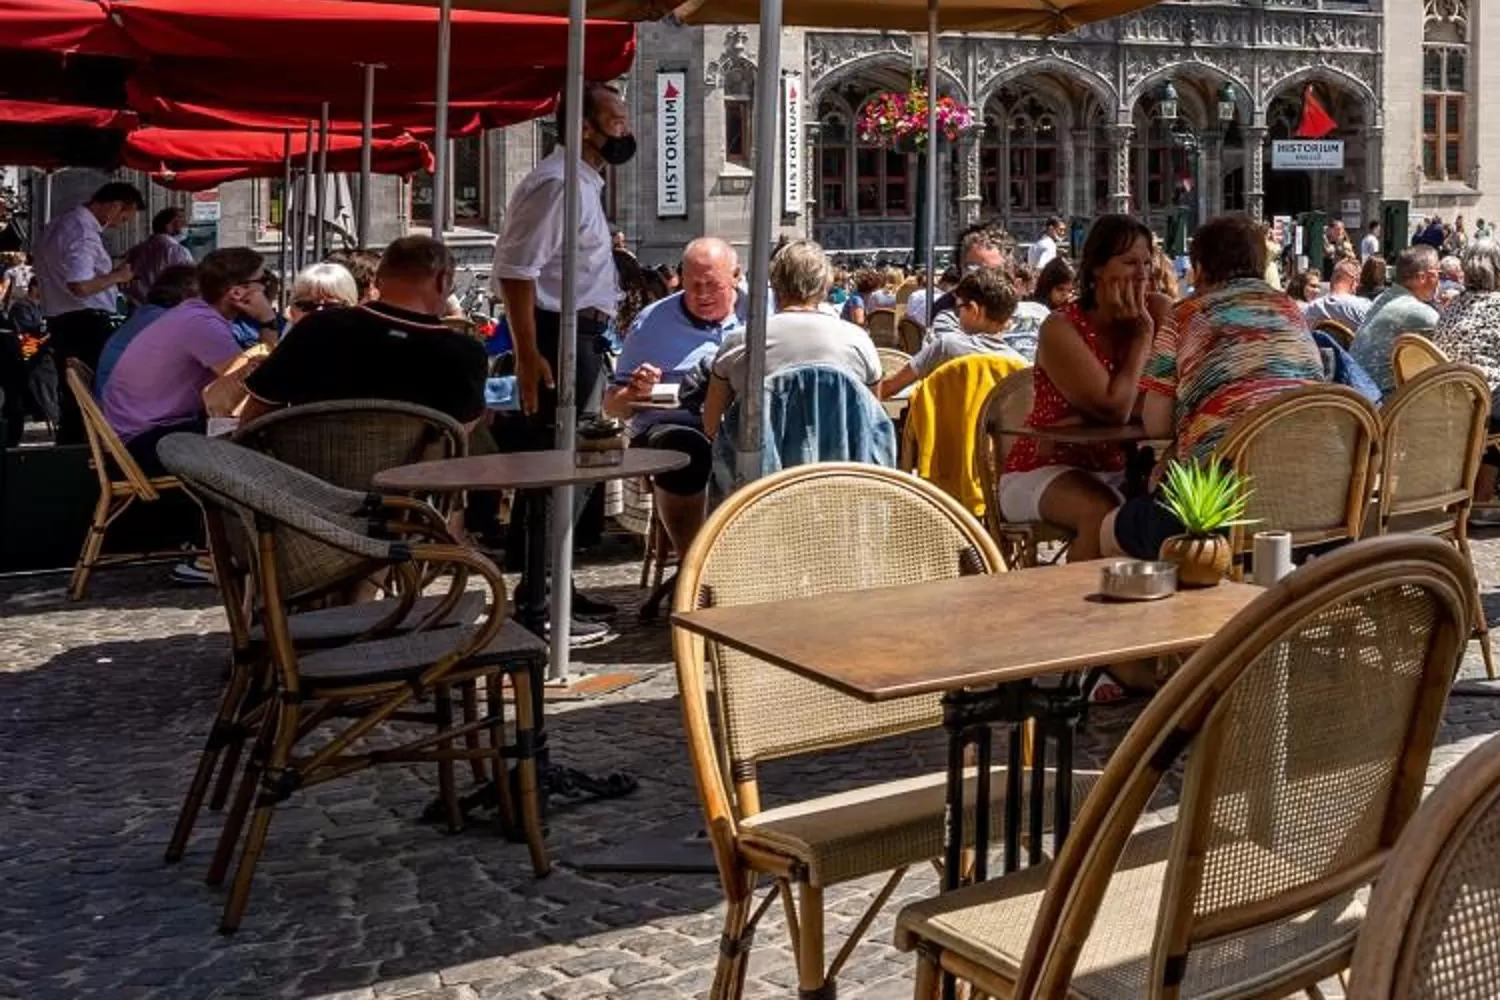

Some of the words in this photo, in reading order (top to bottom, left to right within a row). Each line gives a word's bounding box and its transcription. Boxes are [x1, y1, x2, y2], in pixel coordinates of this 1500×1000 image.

[665, 99, 678, 203] HISTORIUM
[789, 101, 799, 200] HISTORIUM
[1277, 144, 1339, 152] HISTORIUM
